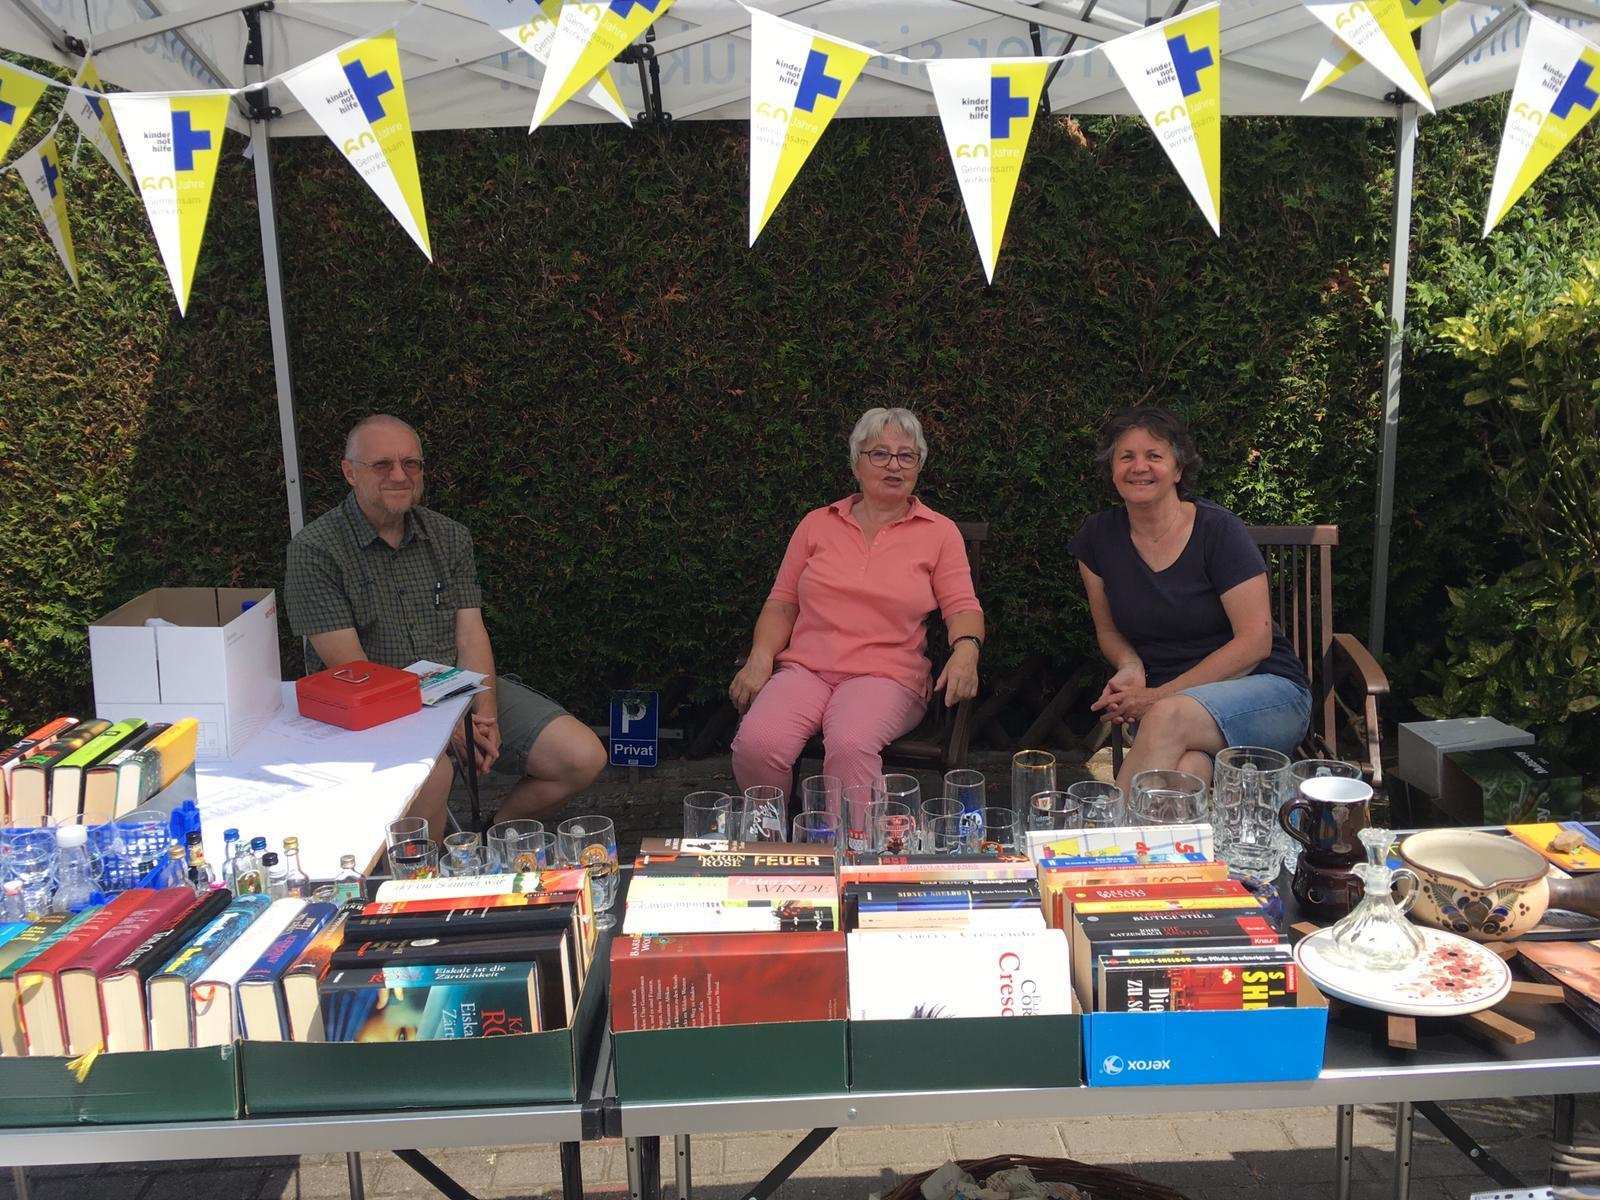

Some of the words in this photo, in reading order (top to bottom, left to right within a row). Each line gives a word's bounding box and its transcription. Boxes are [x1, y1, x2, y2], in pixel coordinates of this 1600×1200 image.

[776, 59, 802, 73] kinder
[1146, 61, 1172, 76] kinder
[1542, 62, 1566, 80] kinder
[786, 70, 800, 79] not
[1160, 68, 1174, 78] not
[779, 75, 799, 87] hilfe
[1157, 75, 1176, 87] hilfe
[1541, 79, 1560, 93] hilfe
[1550, 75, 1563, 87] not
[325, 88, 352, 105] kinder
[340, 94, 355, 105] not
[961, 98, 989, 106] kinder
[339, 101, 359, 115] hilfe
[969, 112, 989, 120] hilfe
[143, 131, 171, 139] kinder
[152, 145, 172, 153] hilfe
[622, 699, 646, 734] P
[614, 743, 654, 756] Privat
[701, 859, 742, 867] ROSE
[754, 855, 820, 867] FEUER
[434, 965, 471, 975] Eiskalt
[474, 965, 487, 973] ist
[489, 964, 506, 972] die
[442, 1008, 456, 1038] Zärt
[460, 1002, 478, 1039] Eiska
[1127, 1059, 1171, 1071] xerox
